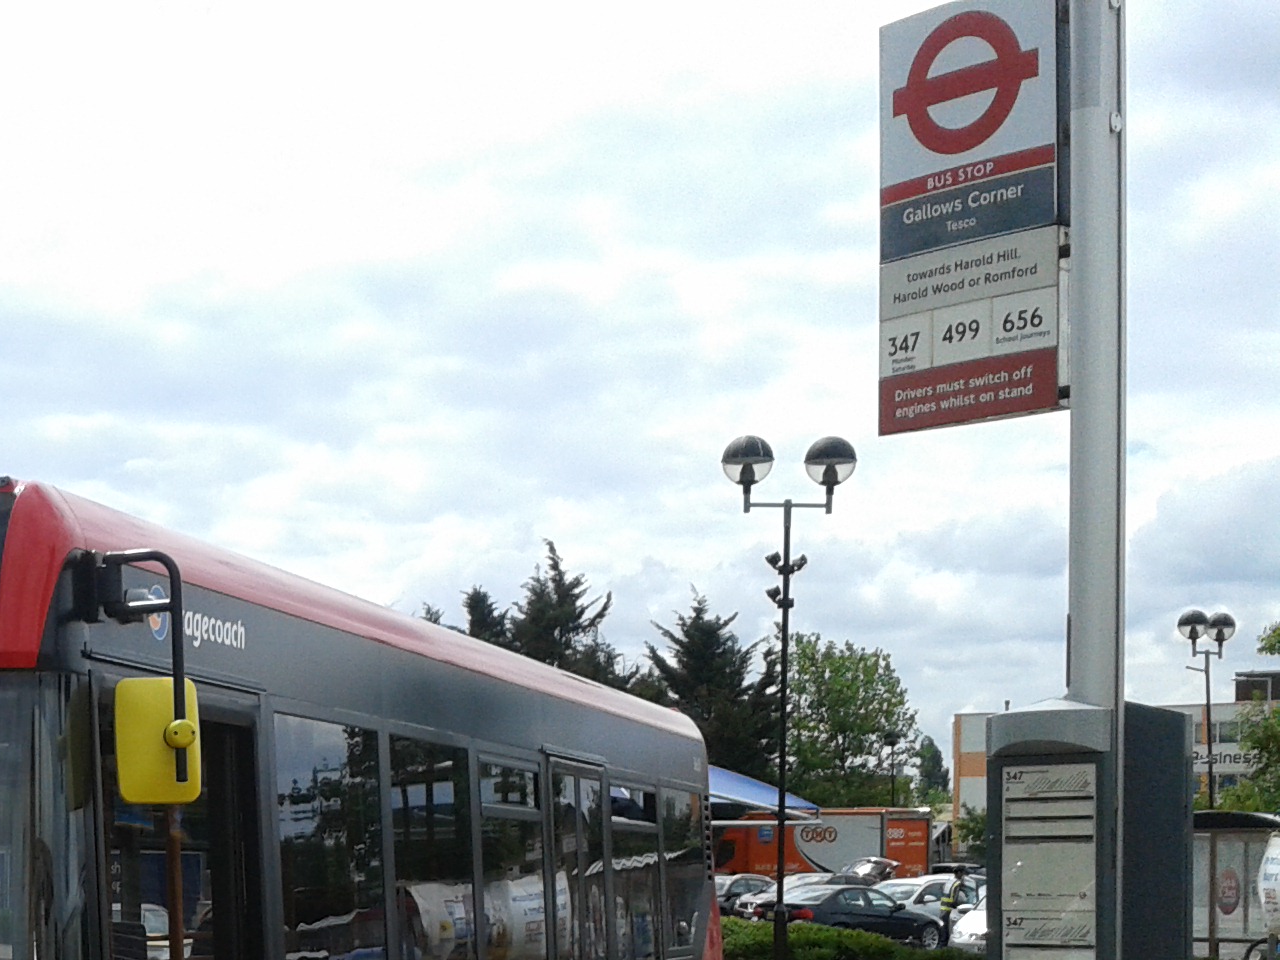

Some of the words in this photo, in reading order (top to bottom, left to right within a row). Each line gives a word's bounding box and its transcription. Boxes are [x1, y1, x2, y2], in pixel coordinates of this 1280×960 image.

[927, 174, 953, 190] BUS
[958, 162, 994, 180] STOP
[903, 198, 963, 224] Gallows
[968, 184, 1024, 208] Corner
[946, 217, 977, 232] Tesco
[907, 263, 951, 283] towards
[954, 252, 993, 272] Harold
[893, 287, 928, 304] Harold
[932, 278, 965, 295] Wood
[968, 276, 981, 288] or
[984, 263, 1038, 284] Romford
[942, 319, 980, 344] 499
[1002, 307, 1043, 333] 656
[888, 332, 920, 357] 347
[895, 385, 933, 402] Drivers
[936, 379, 965, 394] must
[969, 372, 1009, 387] switch
[1013, 366, 1033, 380] off
[895, 401, 936, 419] engines
[940, 393, 975, 409] whilst
[979, 391, 994, 402] on
[998, 384, 1033, 400] stand
